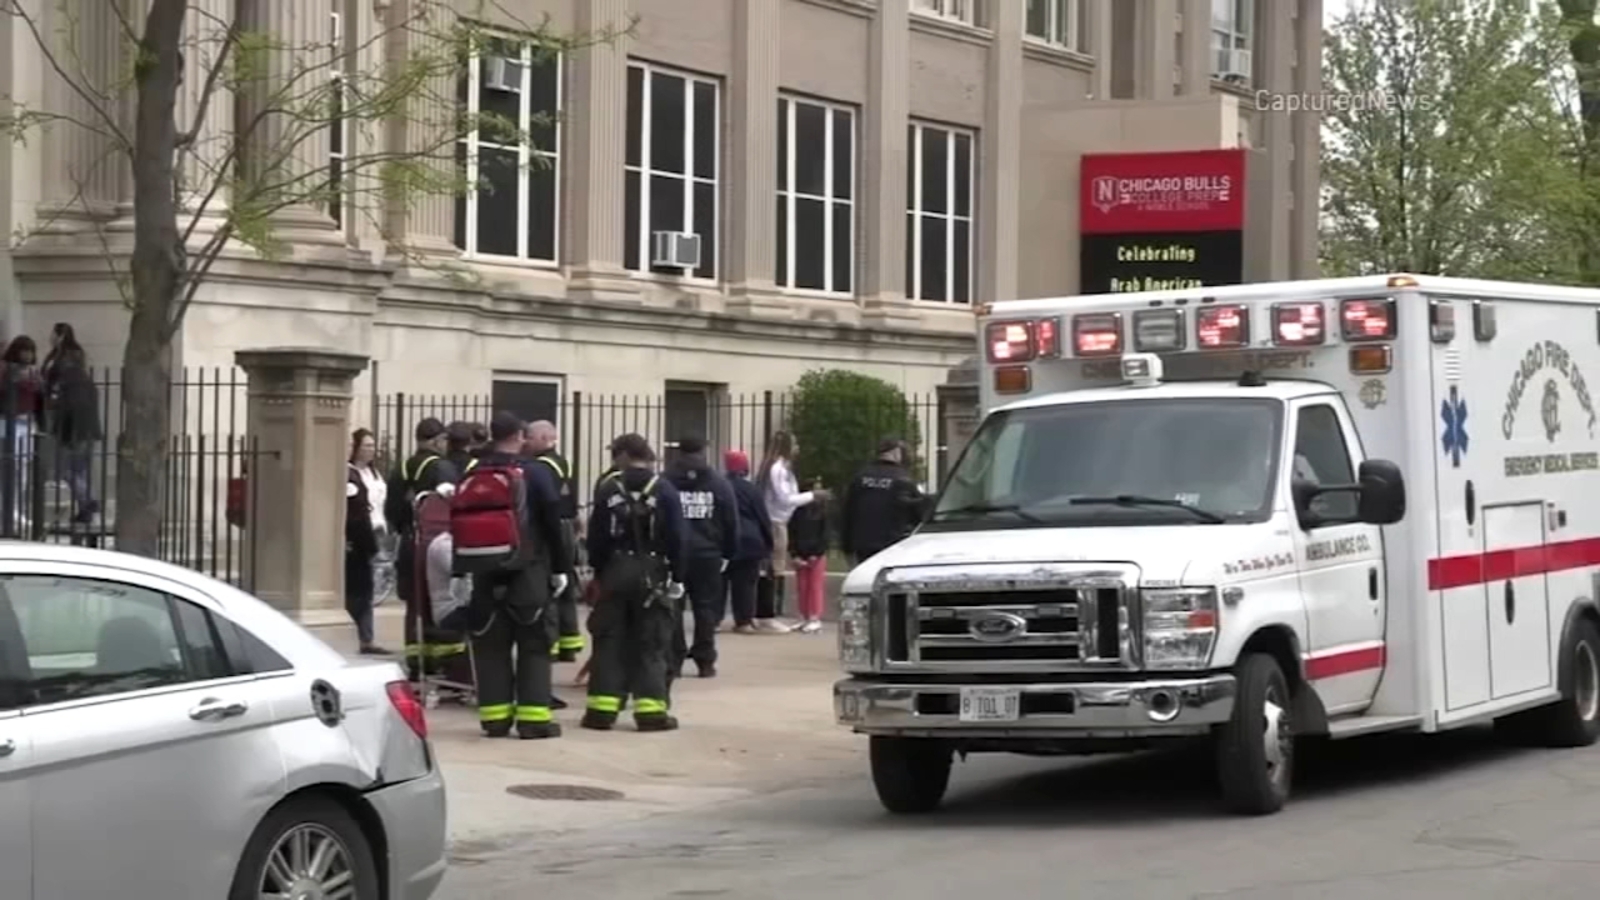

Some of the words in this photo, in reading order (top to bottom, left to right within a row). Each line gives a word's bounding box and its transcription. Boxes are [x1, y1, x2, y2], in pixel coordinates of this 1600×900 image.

[1098, 178, 1114, 202] N
[1120, 178, 1181, 193] CHICAGO
[1183, 175, 1231, 191] BULLS
[1130, 191, 1184, 205] COLLEGE
[1117, 245, 1196, 263] Celebrating
[1110, 276, 1141, 292] Arab
[1144, 276, 1203, 292] American
[1502, 341, 1544, 441] CHICAGO
[1544, 340, 1569, 379] FIRE
[1305, 536, 1355, 562] AMBULANCE
